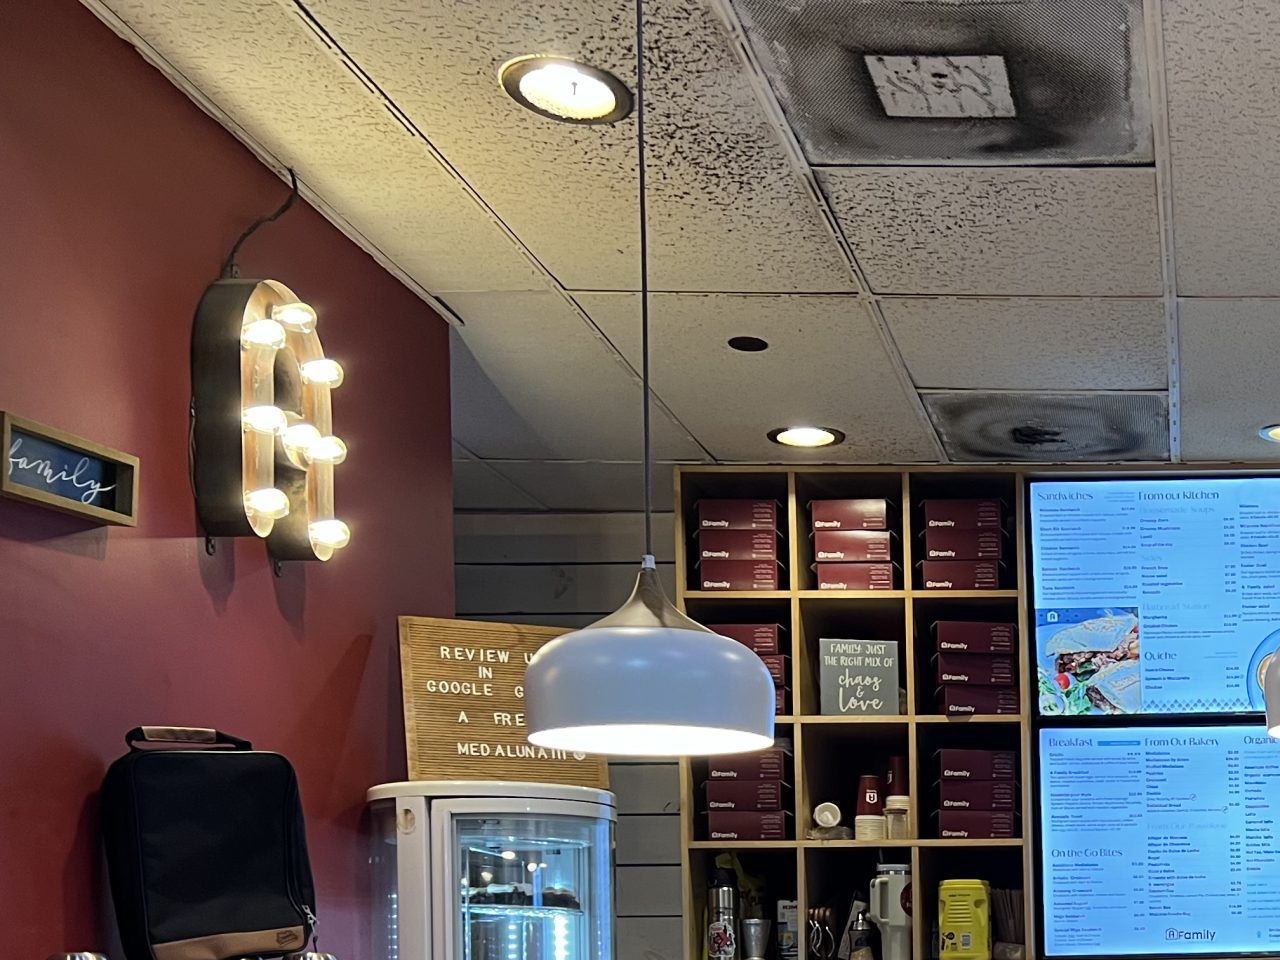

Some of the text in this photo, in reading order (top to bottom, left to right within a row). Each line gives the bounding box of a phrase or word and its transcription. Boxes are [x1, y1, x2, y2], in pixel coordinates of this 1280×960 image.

[8, 438, 117, 505] family
[1037, 491, 1094, 501] Sandwiches
[1138, 490, 1163, 501] From
[1182, 490, 1220, 500] Kitchen
[439, 646, 535, 665] REVIEW U
[865, 644, 886, 655] JUST
[823, 655, 895, 667] THE RIGHT MIX OF
[1144, 651, 1177, 661] Quiche
[478, 666, 493, 680] IN
[838, 668, 882, 691] chaos
[426, 680, 494, 697] GOOGLE
[856, 685, 865, 698] &
[458, 711, 527, 727] A FRE
[1049, 737, 1093, 747] Breakfast
[1145, 737, 1219, 748] From Our Bakery
[1243, 735, 1276, 745] Organic
[1051, 847, 1123, 858] On the Go Bites
[1178, 929, 1216, 942] Family
